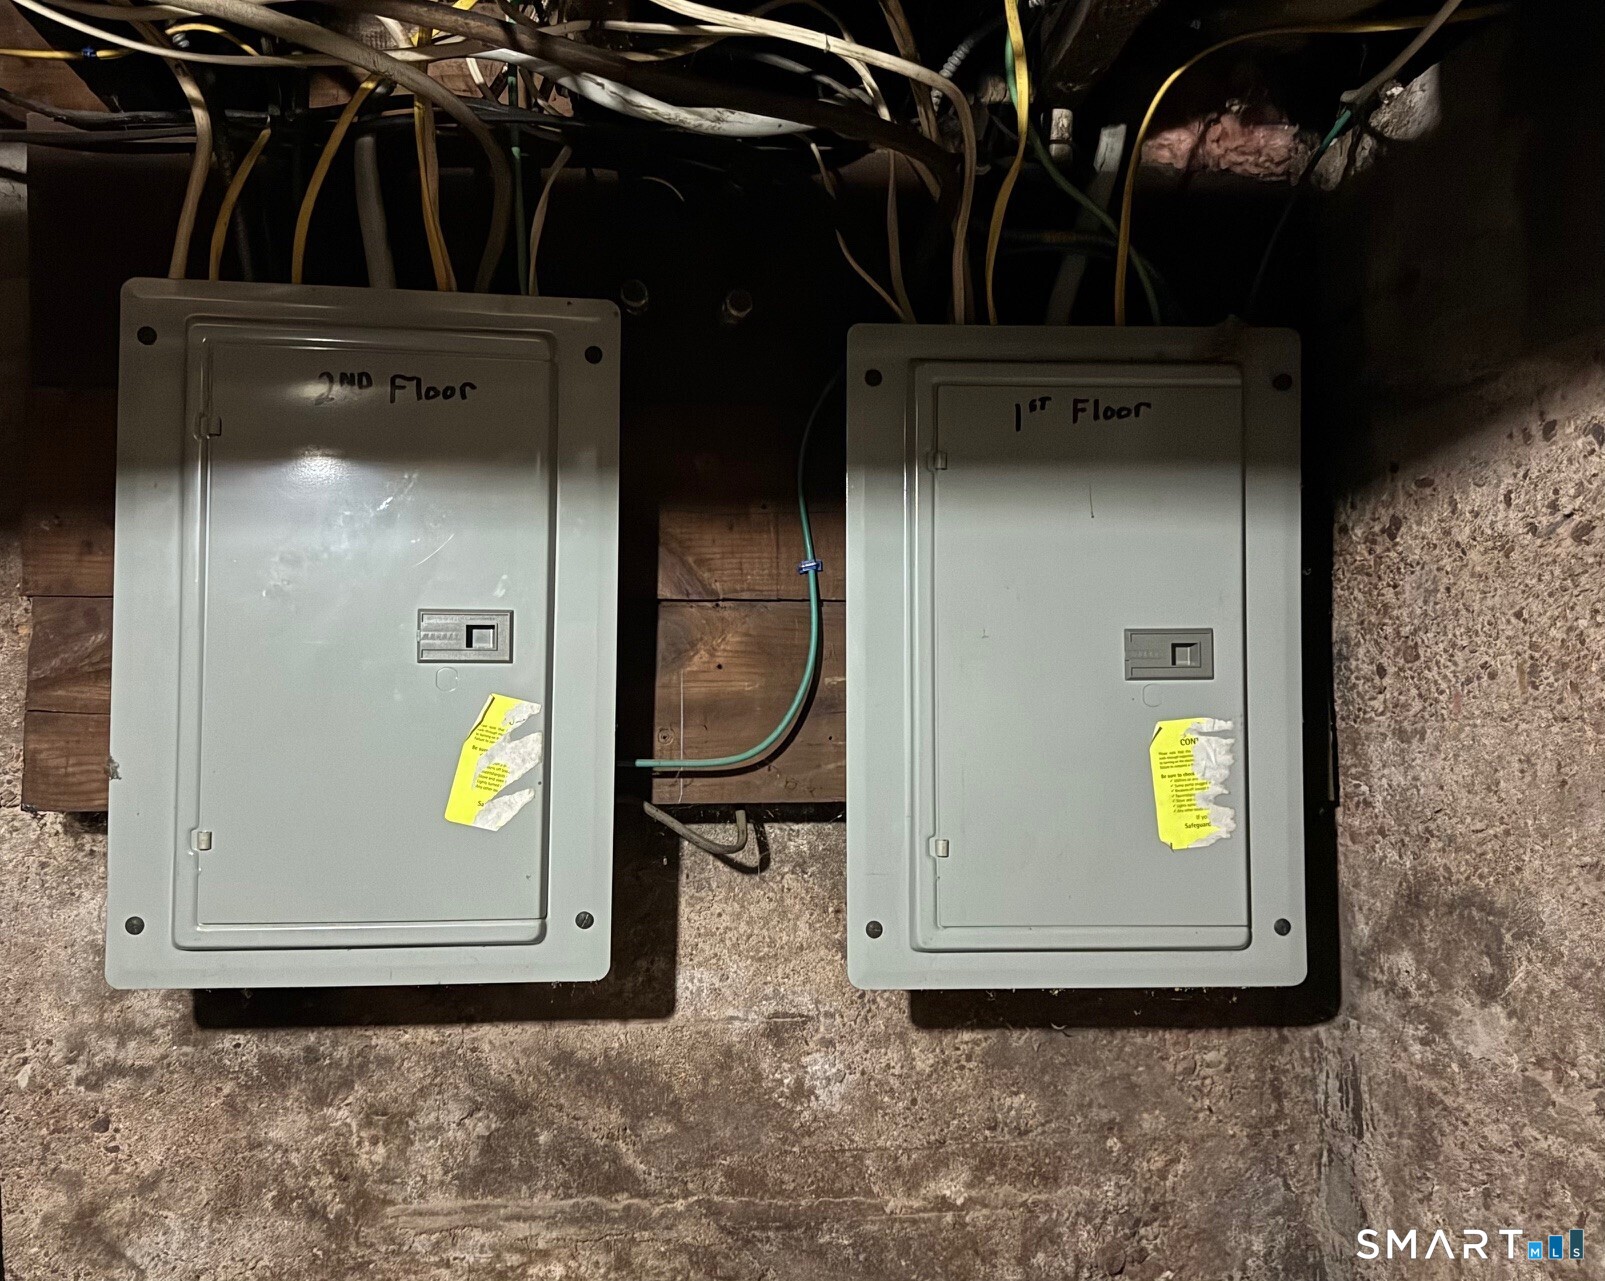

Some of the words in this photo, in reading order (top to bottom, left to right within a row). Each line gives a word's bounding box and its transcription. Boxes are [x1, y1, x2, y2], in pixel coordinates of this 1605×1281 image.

[314, 371, 373, 406] 2ND
[389, 374, 477, 404] Floor
[1014, 396, 1052, 432] 1ST
[1072, 398, 1152, 424] Floor
